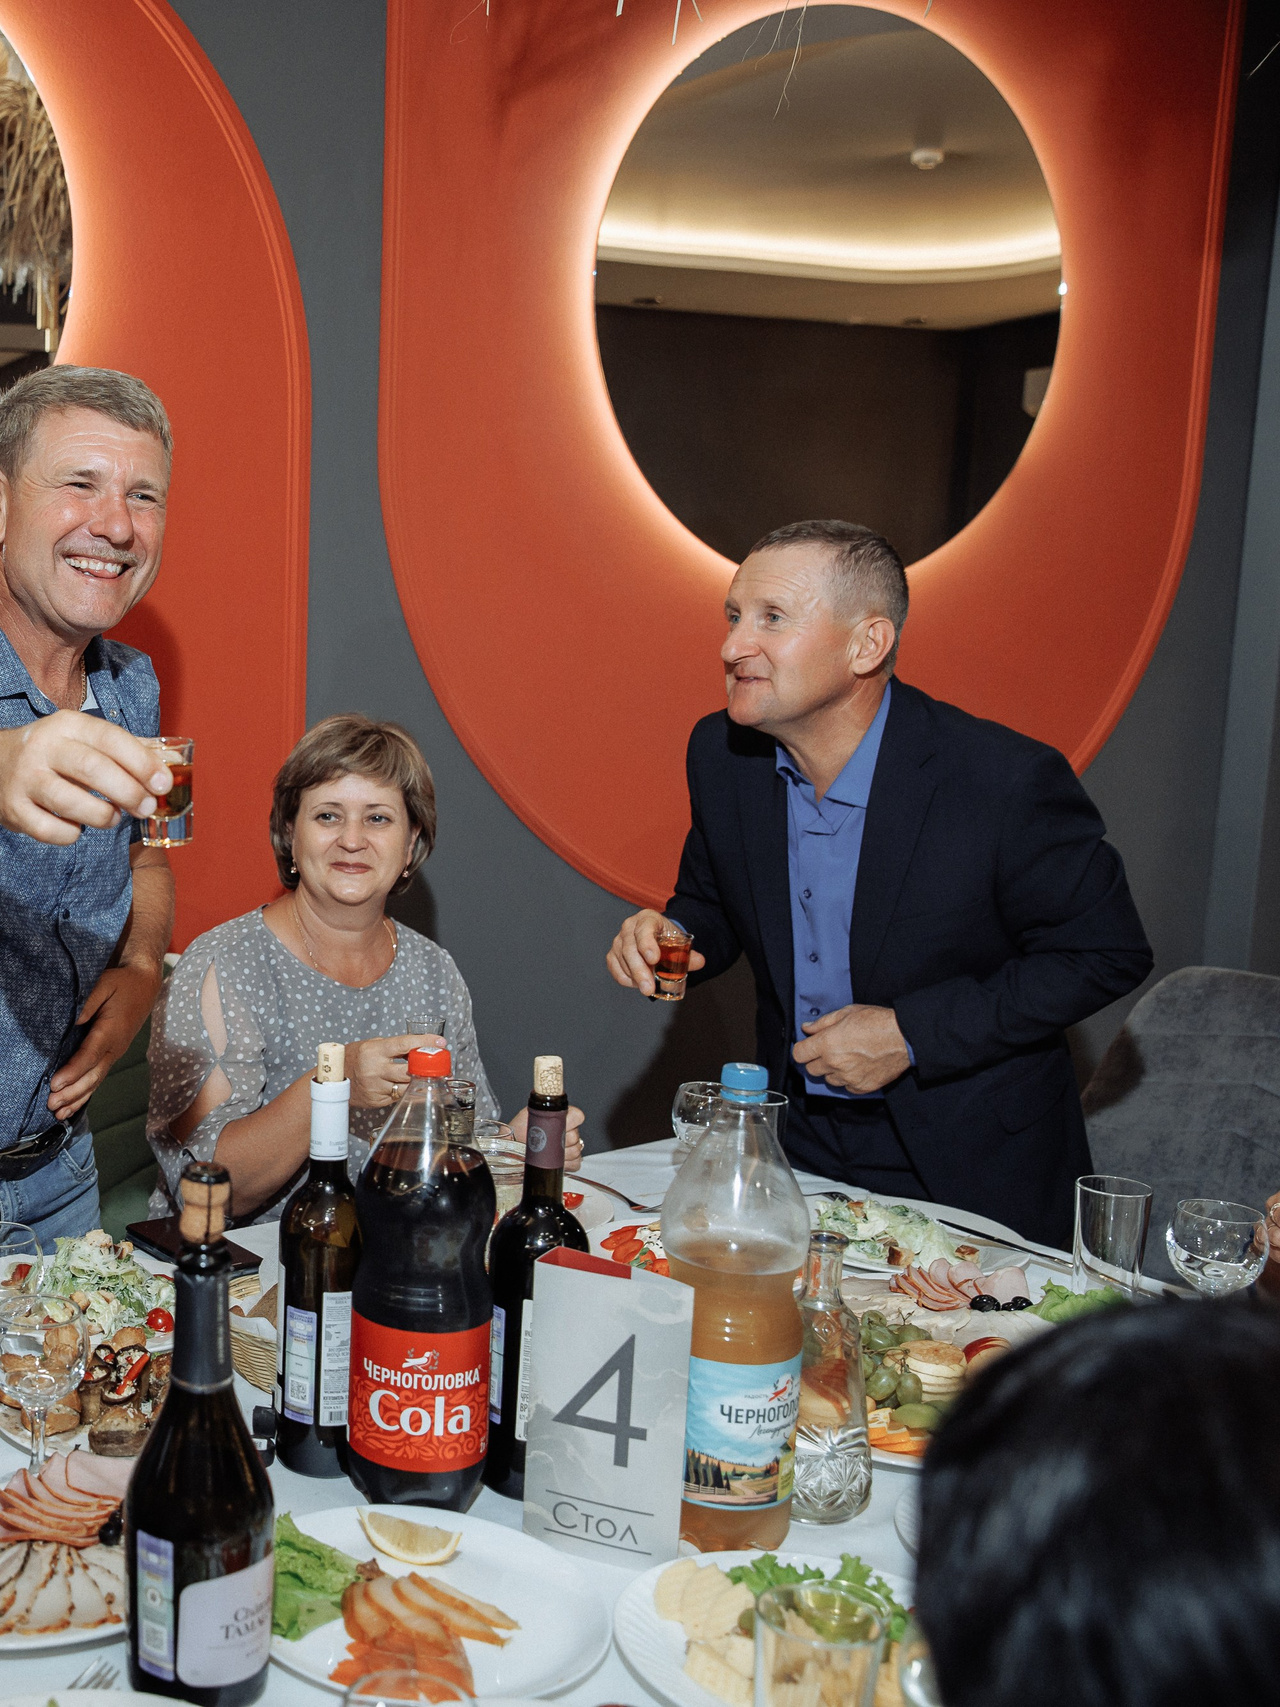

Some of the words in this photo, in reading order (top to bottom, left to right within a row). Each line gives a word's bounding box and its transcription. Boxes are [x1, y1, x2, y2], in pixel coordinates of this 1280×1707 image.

[363, 1357, 480, 1391] ЧЕРНОГОЛОВКА
[369, 1389, 471, 1436] Cola
[552, 1333, 647, 1468] 4
